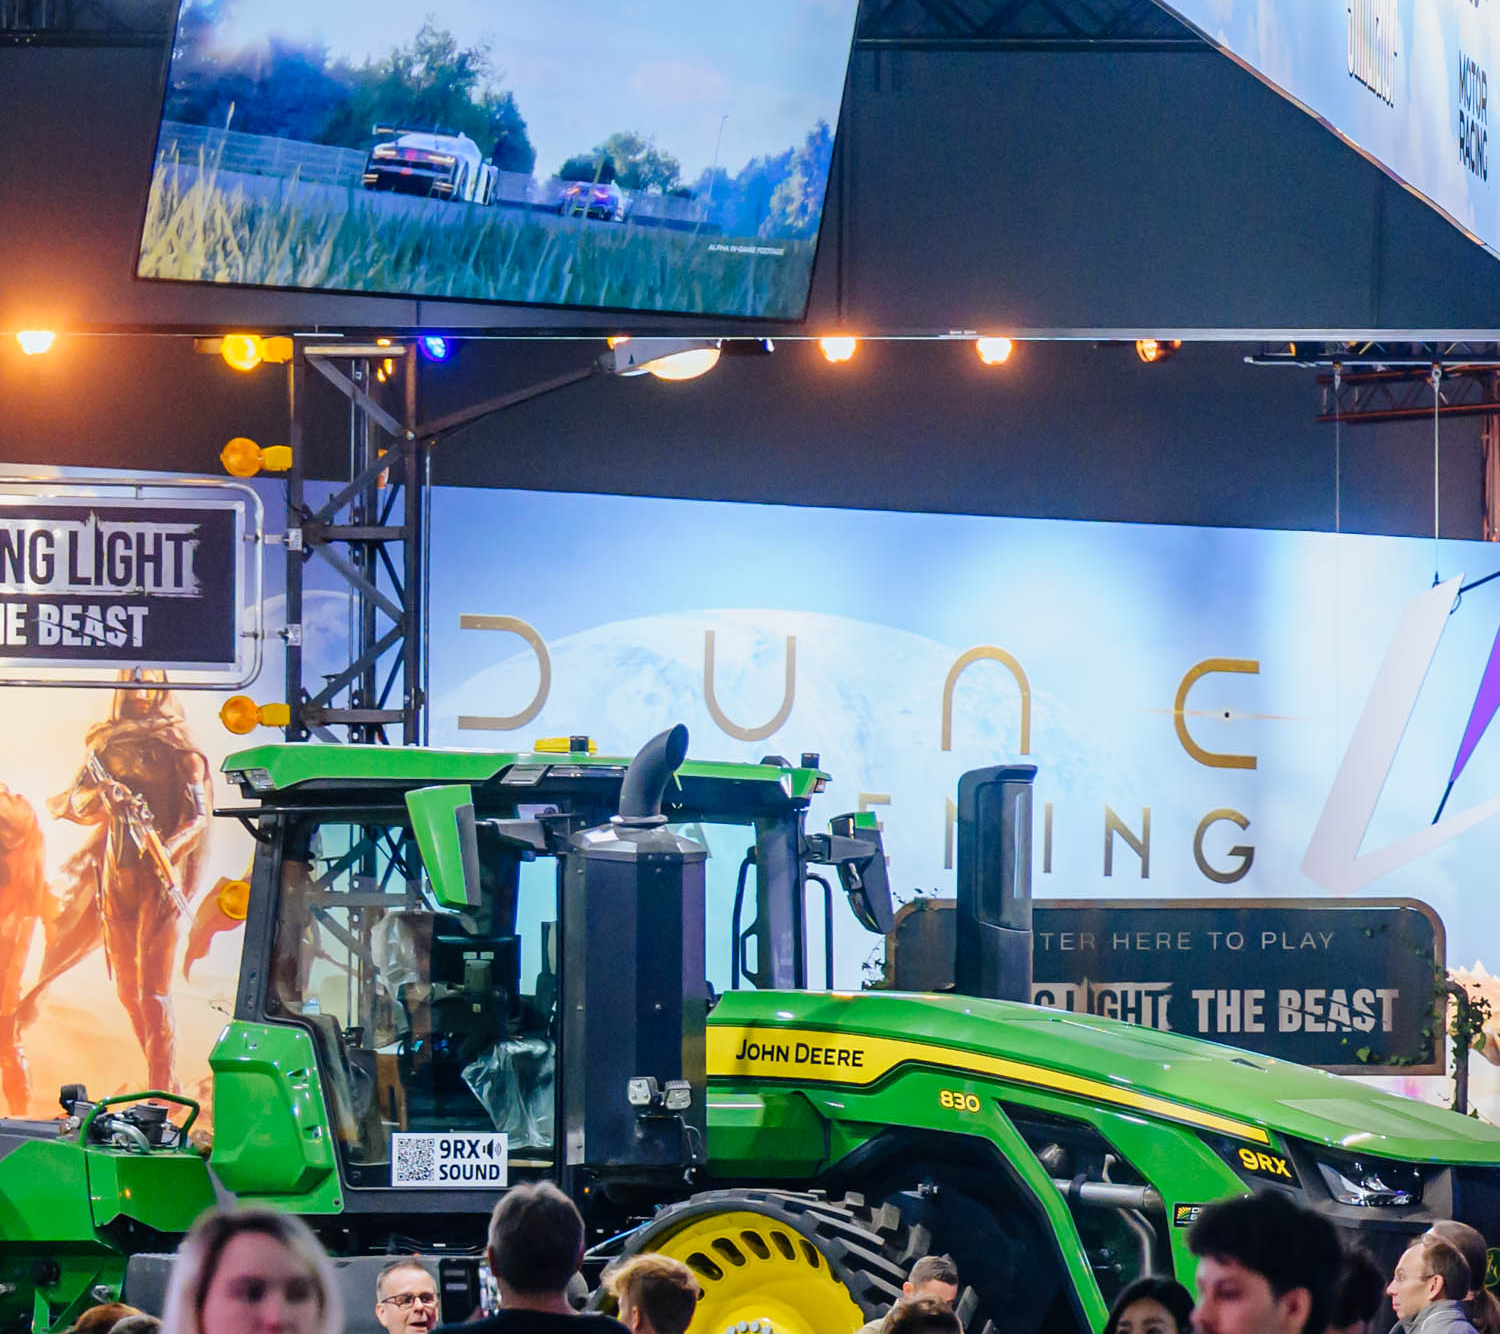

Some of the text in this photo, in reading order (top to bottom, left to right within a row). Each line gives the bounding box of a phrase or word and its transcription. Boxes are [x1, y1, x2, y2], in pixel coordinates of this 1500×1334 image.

[1459, 49, 1488, 126] MOTOR
[1459, 108, 1488, 183] RACING
[69, 530, 193, 588] LIGHT
[38, 603, 149, 648] BEAST
[1040, 931, 1334, 951] TER HERE TO PLAY
[1192, 989, 1265, 1033] THE
[1279, 988, 1400, 1034] BEAST
[736, 1039, 864, 1068] JOHN DEERE
[939, 1089, 982, 1113] 830
[439, 1139, 481, 1160] 9RX
[1238, 1148, 1293, 1178] 9RX
[439, 1163, 500, 1181] SOUND
